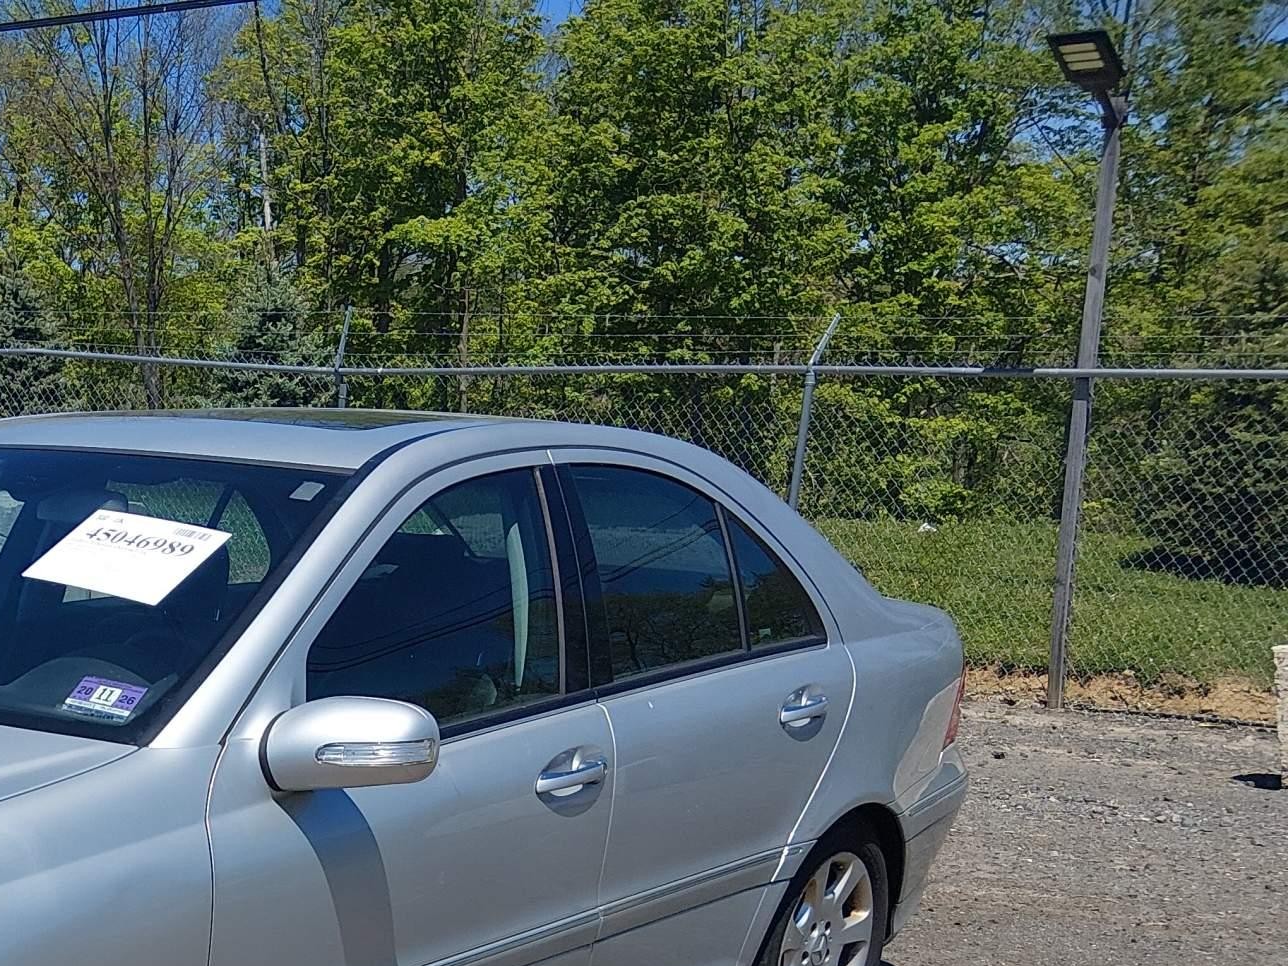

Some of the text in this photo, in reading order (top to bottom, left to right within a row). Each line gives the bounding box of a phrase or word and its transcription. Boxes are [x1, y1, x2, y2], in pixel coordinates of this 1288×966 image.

[86, 527, 195, 557] 45046989
[77, 685, 94, 696] 20
[96, 688, 114, 702] 11
[119, 694, 137, 705] 26
